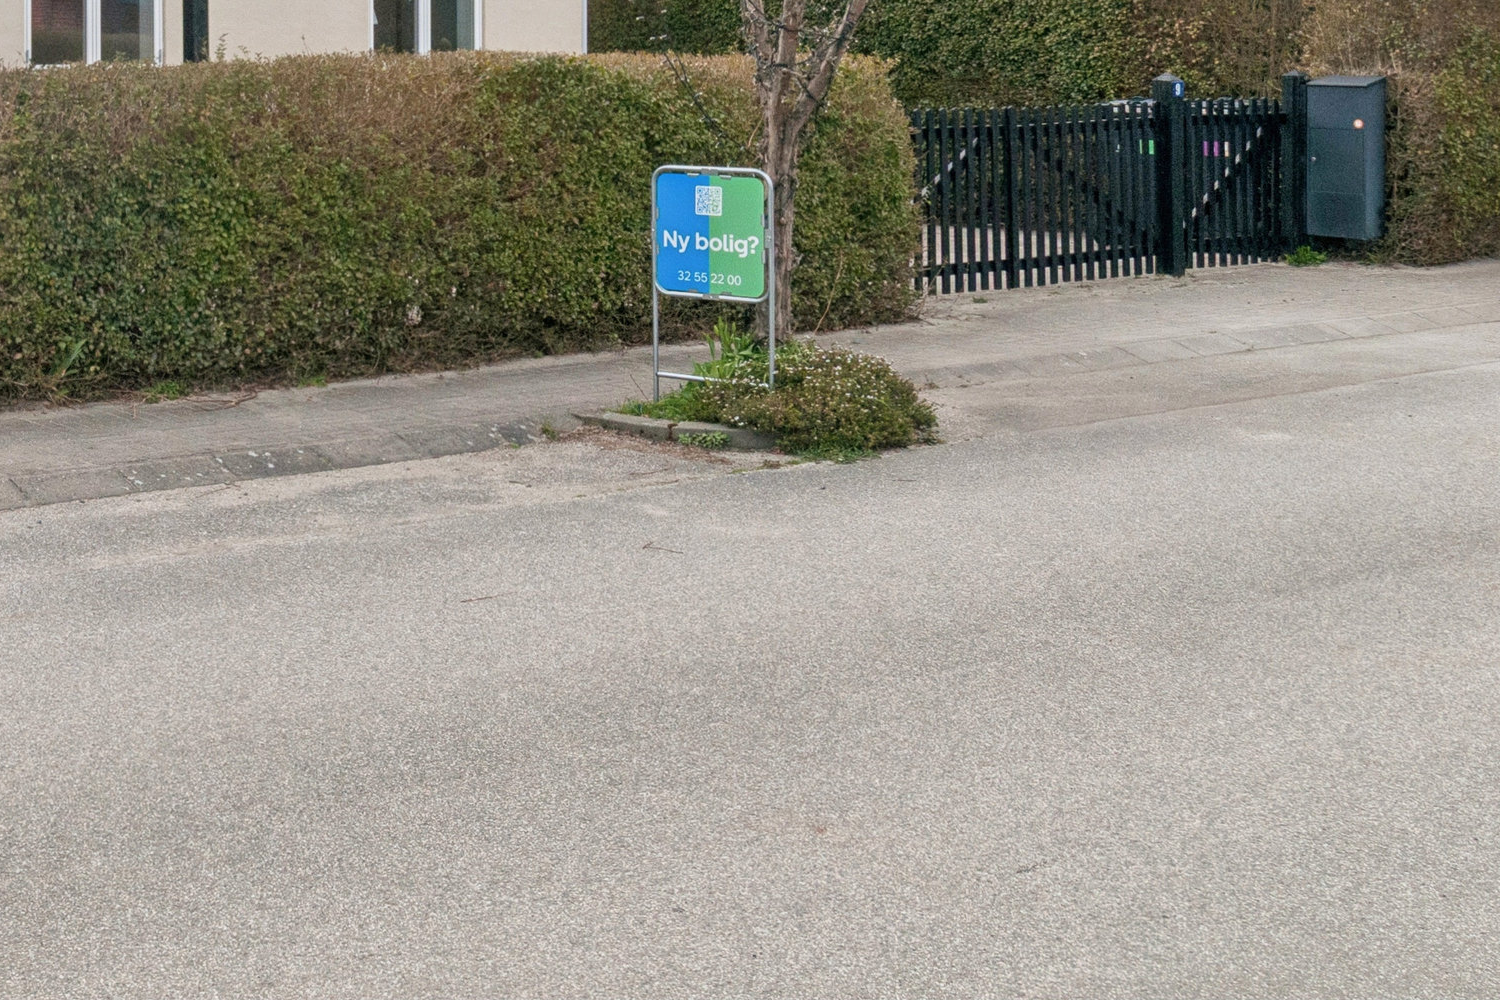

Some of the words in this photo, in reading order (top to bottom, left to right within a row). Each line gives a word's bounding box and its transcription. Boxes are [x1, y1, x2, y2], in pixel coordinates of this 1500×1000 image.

[1175, 83, 1181, 96] 9
[663, 229, 691, 254] Ny
[695, 232, 760, 258] bolig?
[677, 270, 691, 282] 32
[694, 272, 708, 283] 55
[710, 273, 725, 285] 22
[727, 274, 742, 286] 00
